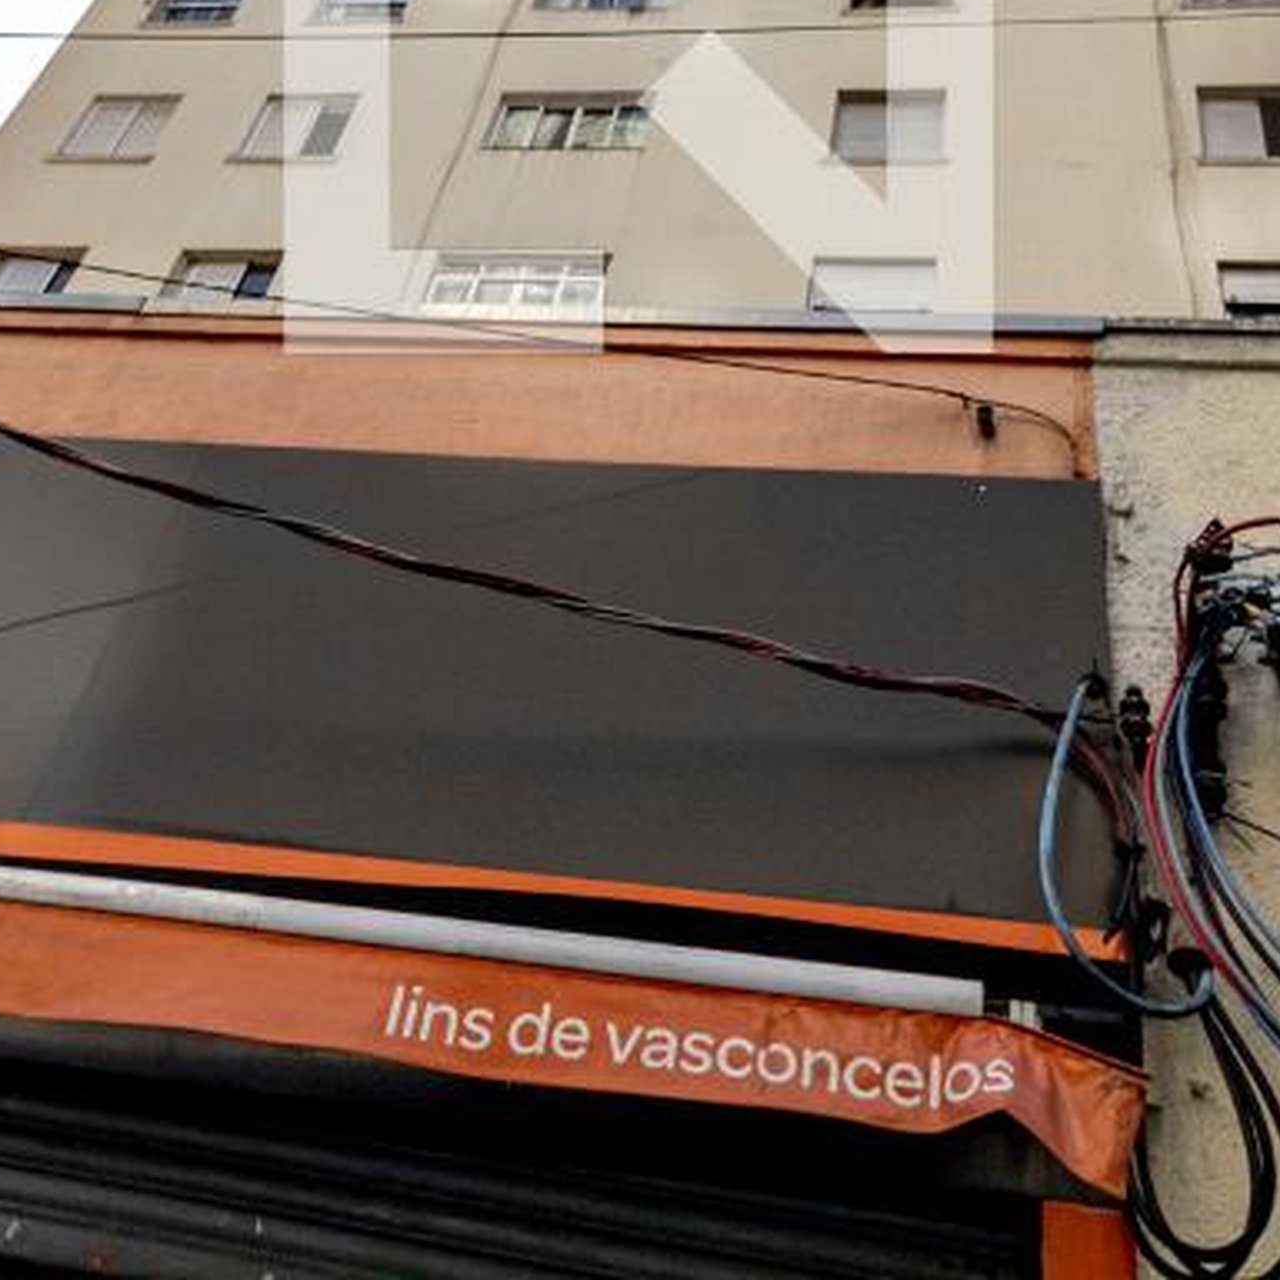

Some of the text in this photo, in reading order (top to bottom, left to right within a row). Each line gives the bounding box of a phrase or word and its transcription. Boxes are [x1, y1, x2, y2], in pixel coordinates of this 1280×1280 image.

[385, 985, 1015, 1110] lins de vasconcelos
